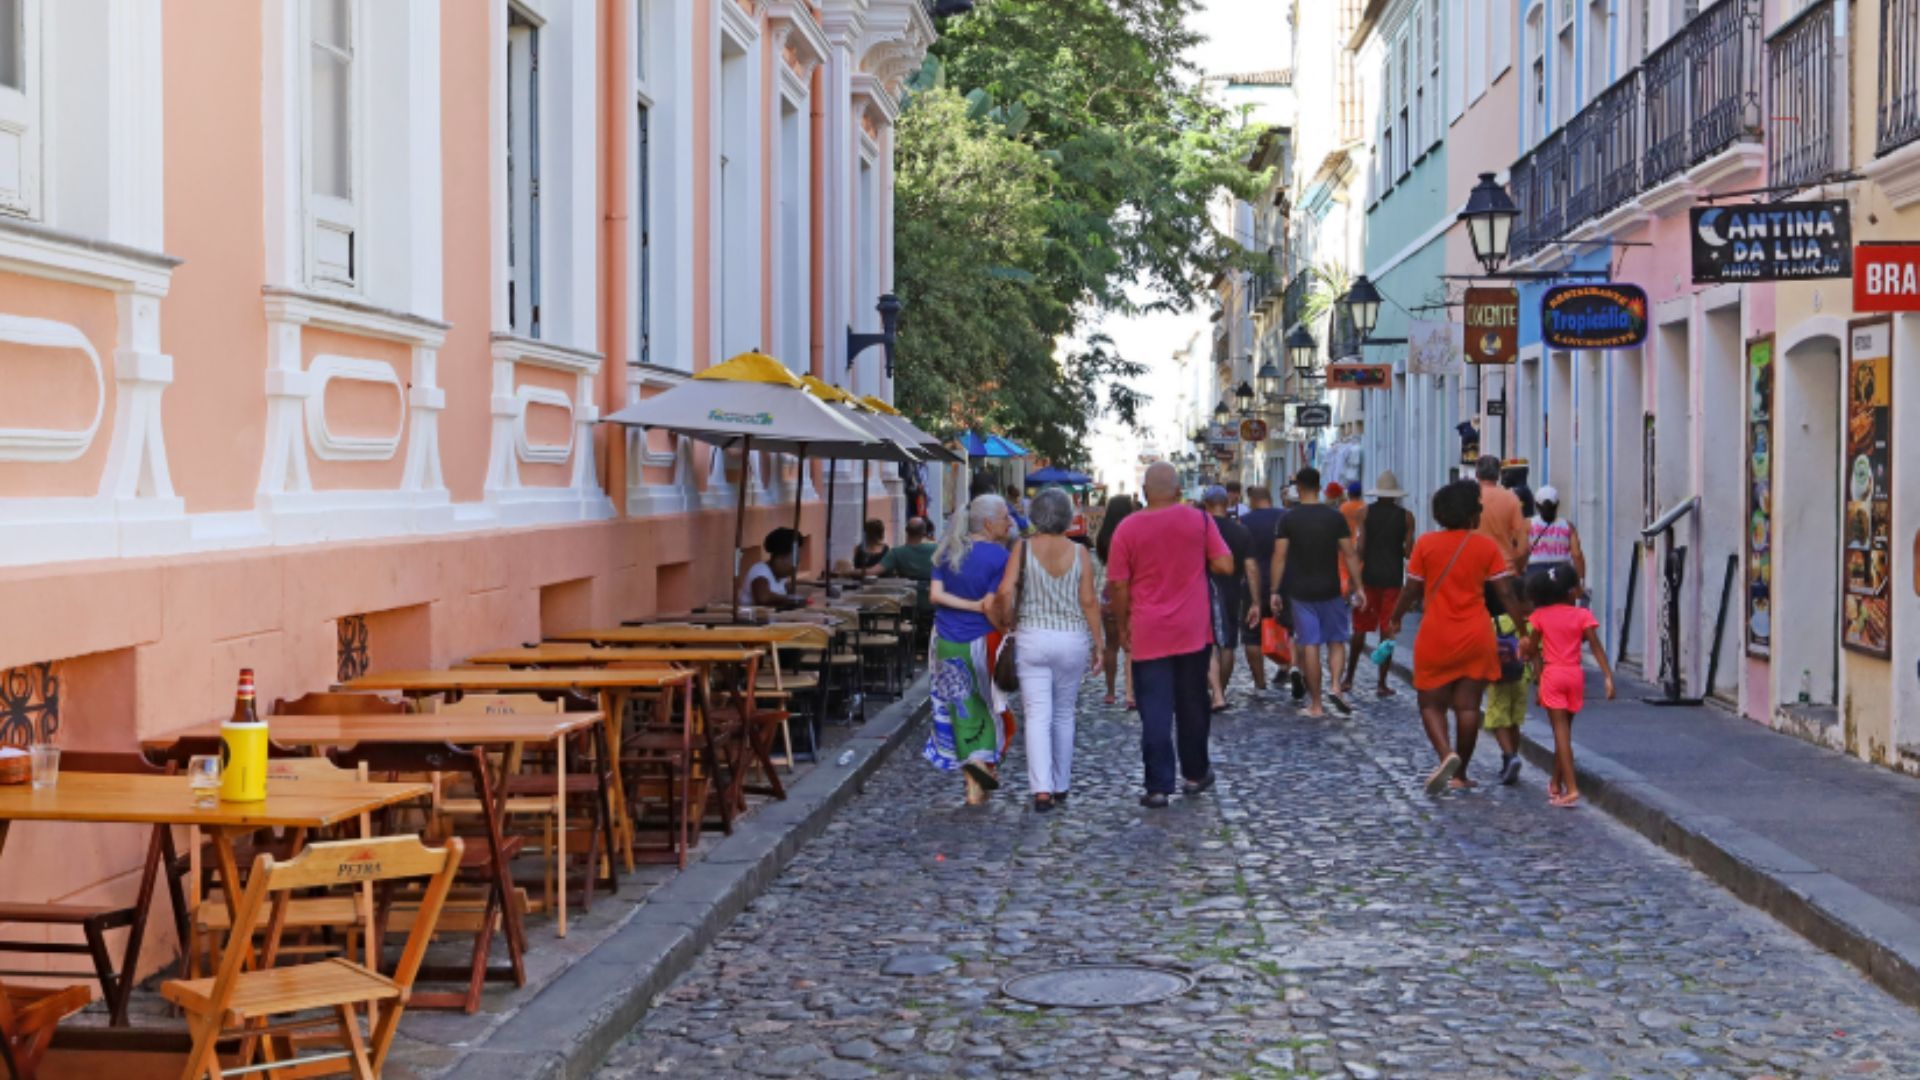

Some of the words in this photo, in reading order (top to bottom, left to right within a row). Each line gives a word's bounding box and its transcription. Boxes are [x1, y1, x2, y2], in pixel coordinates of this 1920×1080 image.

[1698, 208, 1835, 246] CANTINA
[1733, 240, 1765, 262] DA
[1774, 238, 1822, 260] LUA
[1866, 262, 1920, 295] BRA
[337, 862, 382, 877] PETRA
